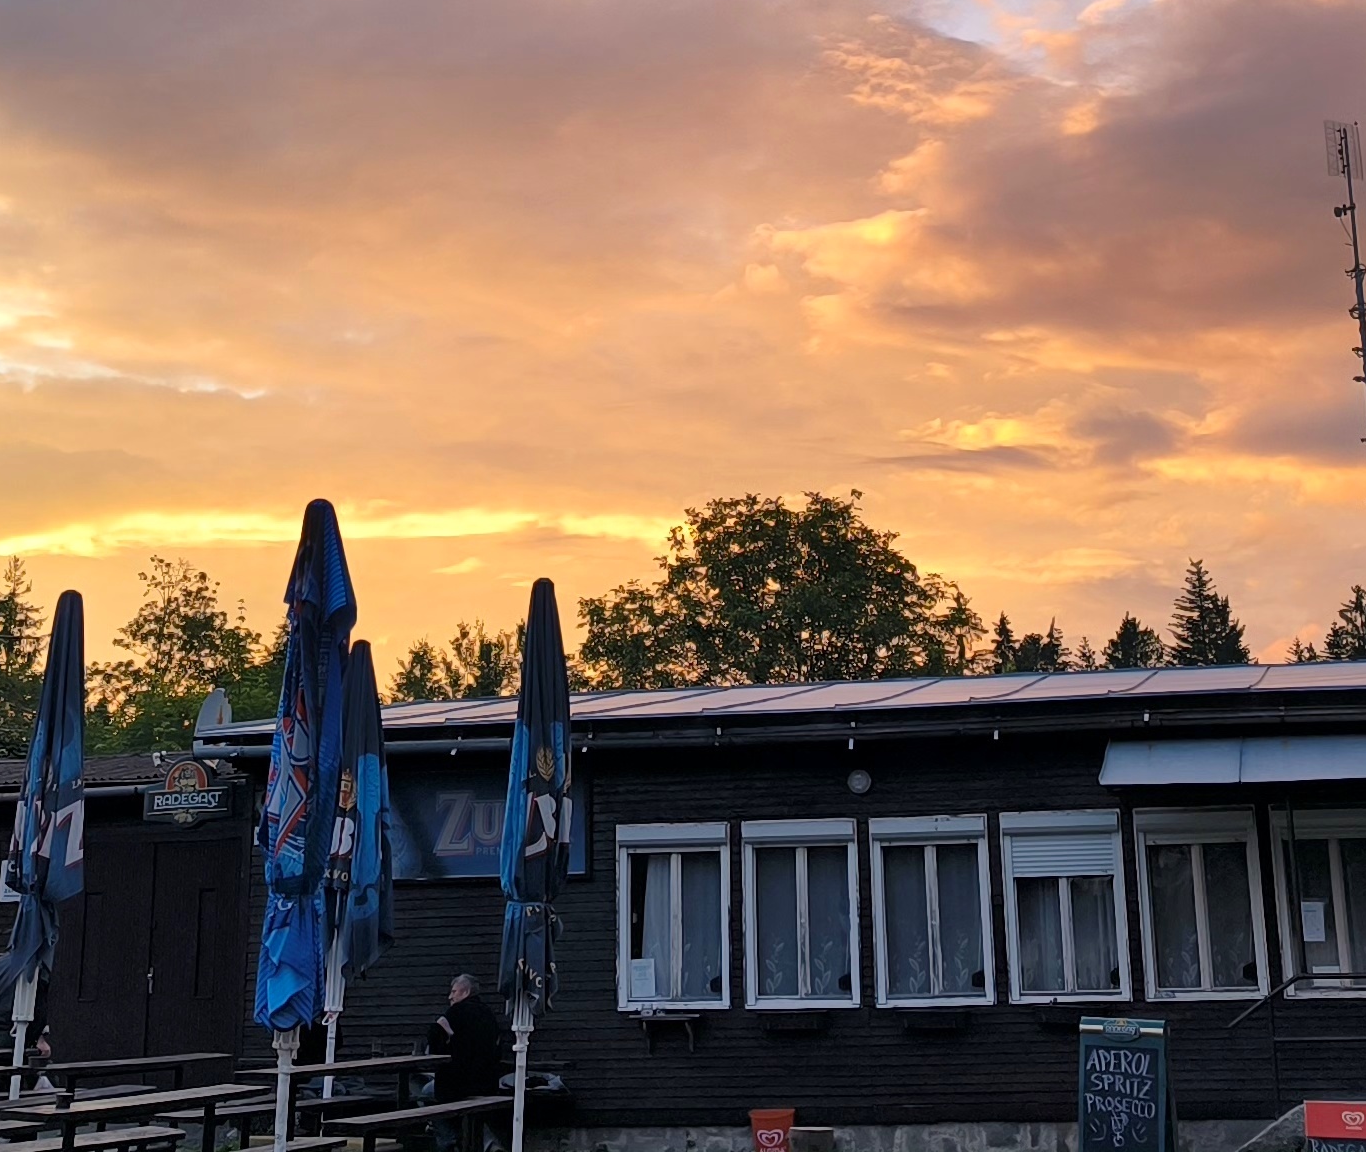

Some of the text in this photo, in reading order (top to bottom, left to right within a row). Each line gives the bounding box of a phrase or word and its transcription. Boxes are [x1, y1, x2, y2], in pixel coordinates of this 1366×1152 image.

[154, 791, 222, 810] RADEGAST
[1086, 1049, 1155, 1078] APEROL
[1090, 1073, 1153, 1100] SPRITZ
[1084, 1093, 1156, 1119] PROSECCO
